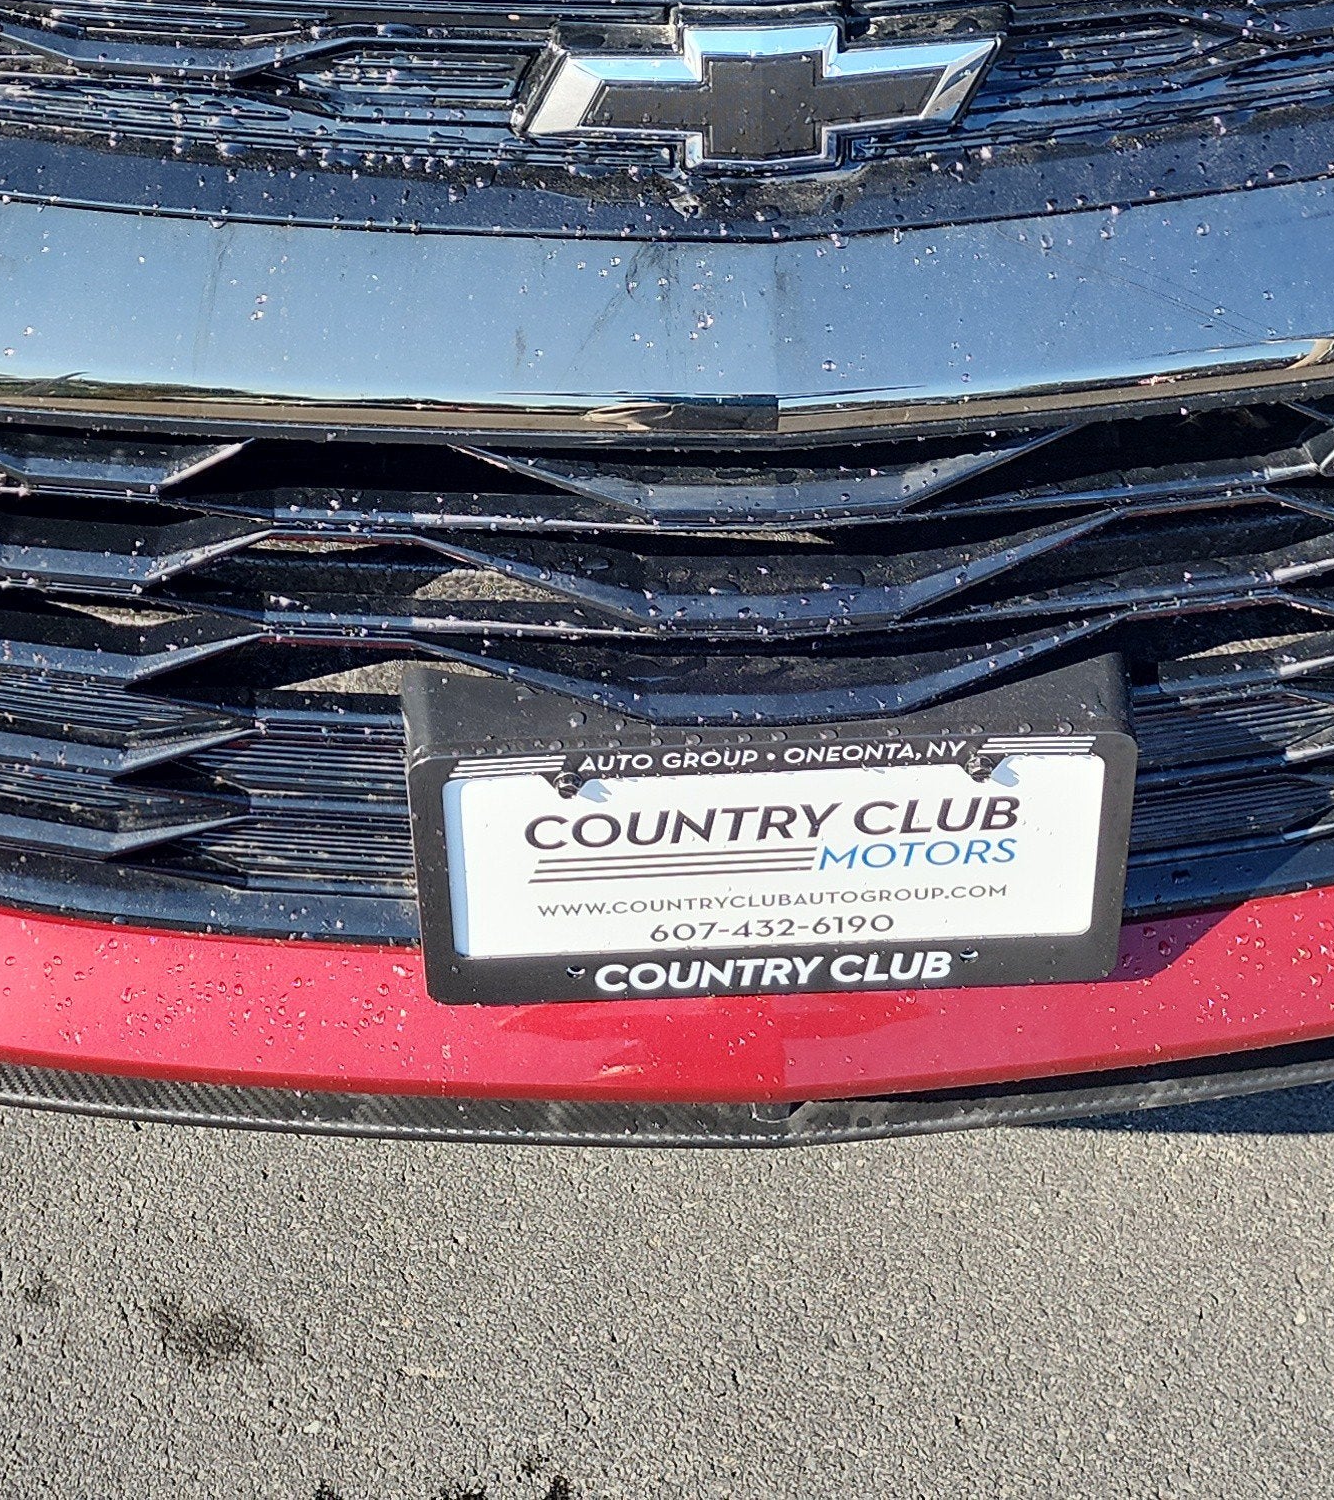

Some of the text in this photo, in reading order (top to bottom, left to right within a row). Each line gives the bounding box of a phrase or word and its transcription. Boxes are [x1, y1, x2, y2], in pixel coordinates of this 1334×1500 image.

[578, 753, 654, 772] AUTO
[662, 750, 759, 769] GROUP
[926, 740, 967, 758] NY
[524, 795, 1021, 850] COUNTRY CLUB
[817, 837, 1018, 871] MOTORS
[537, 884, 1008, 918] WWW.COUNTRYCLUBAUTOGROUP.COM
[649, 913, 895, 943] 607-432-6190
[593, 950, 952, 993] COUNTRY CLUB
